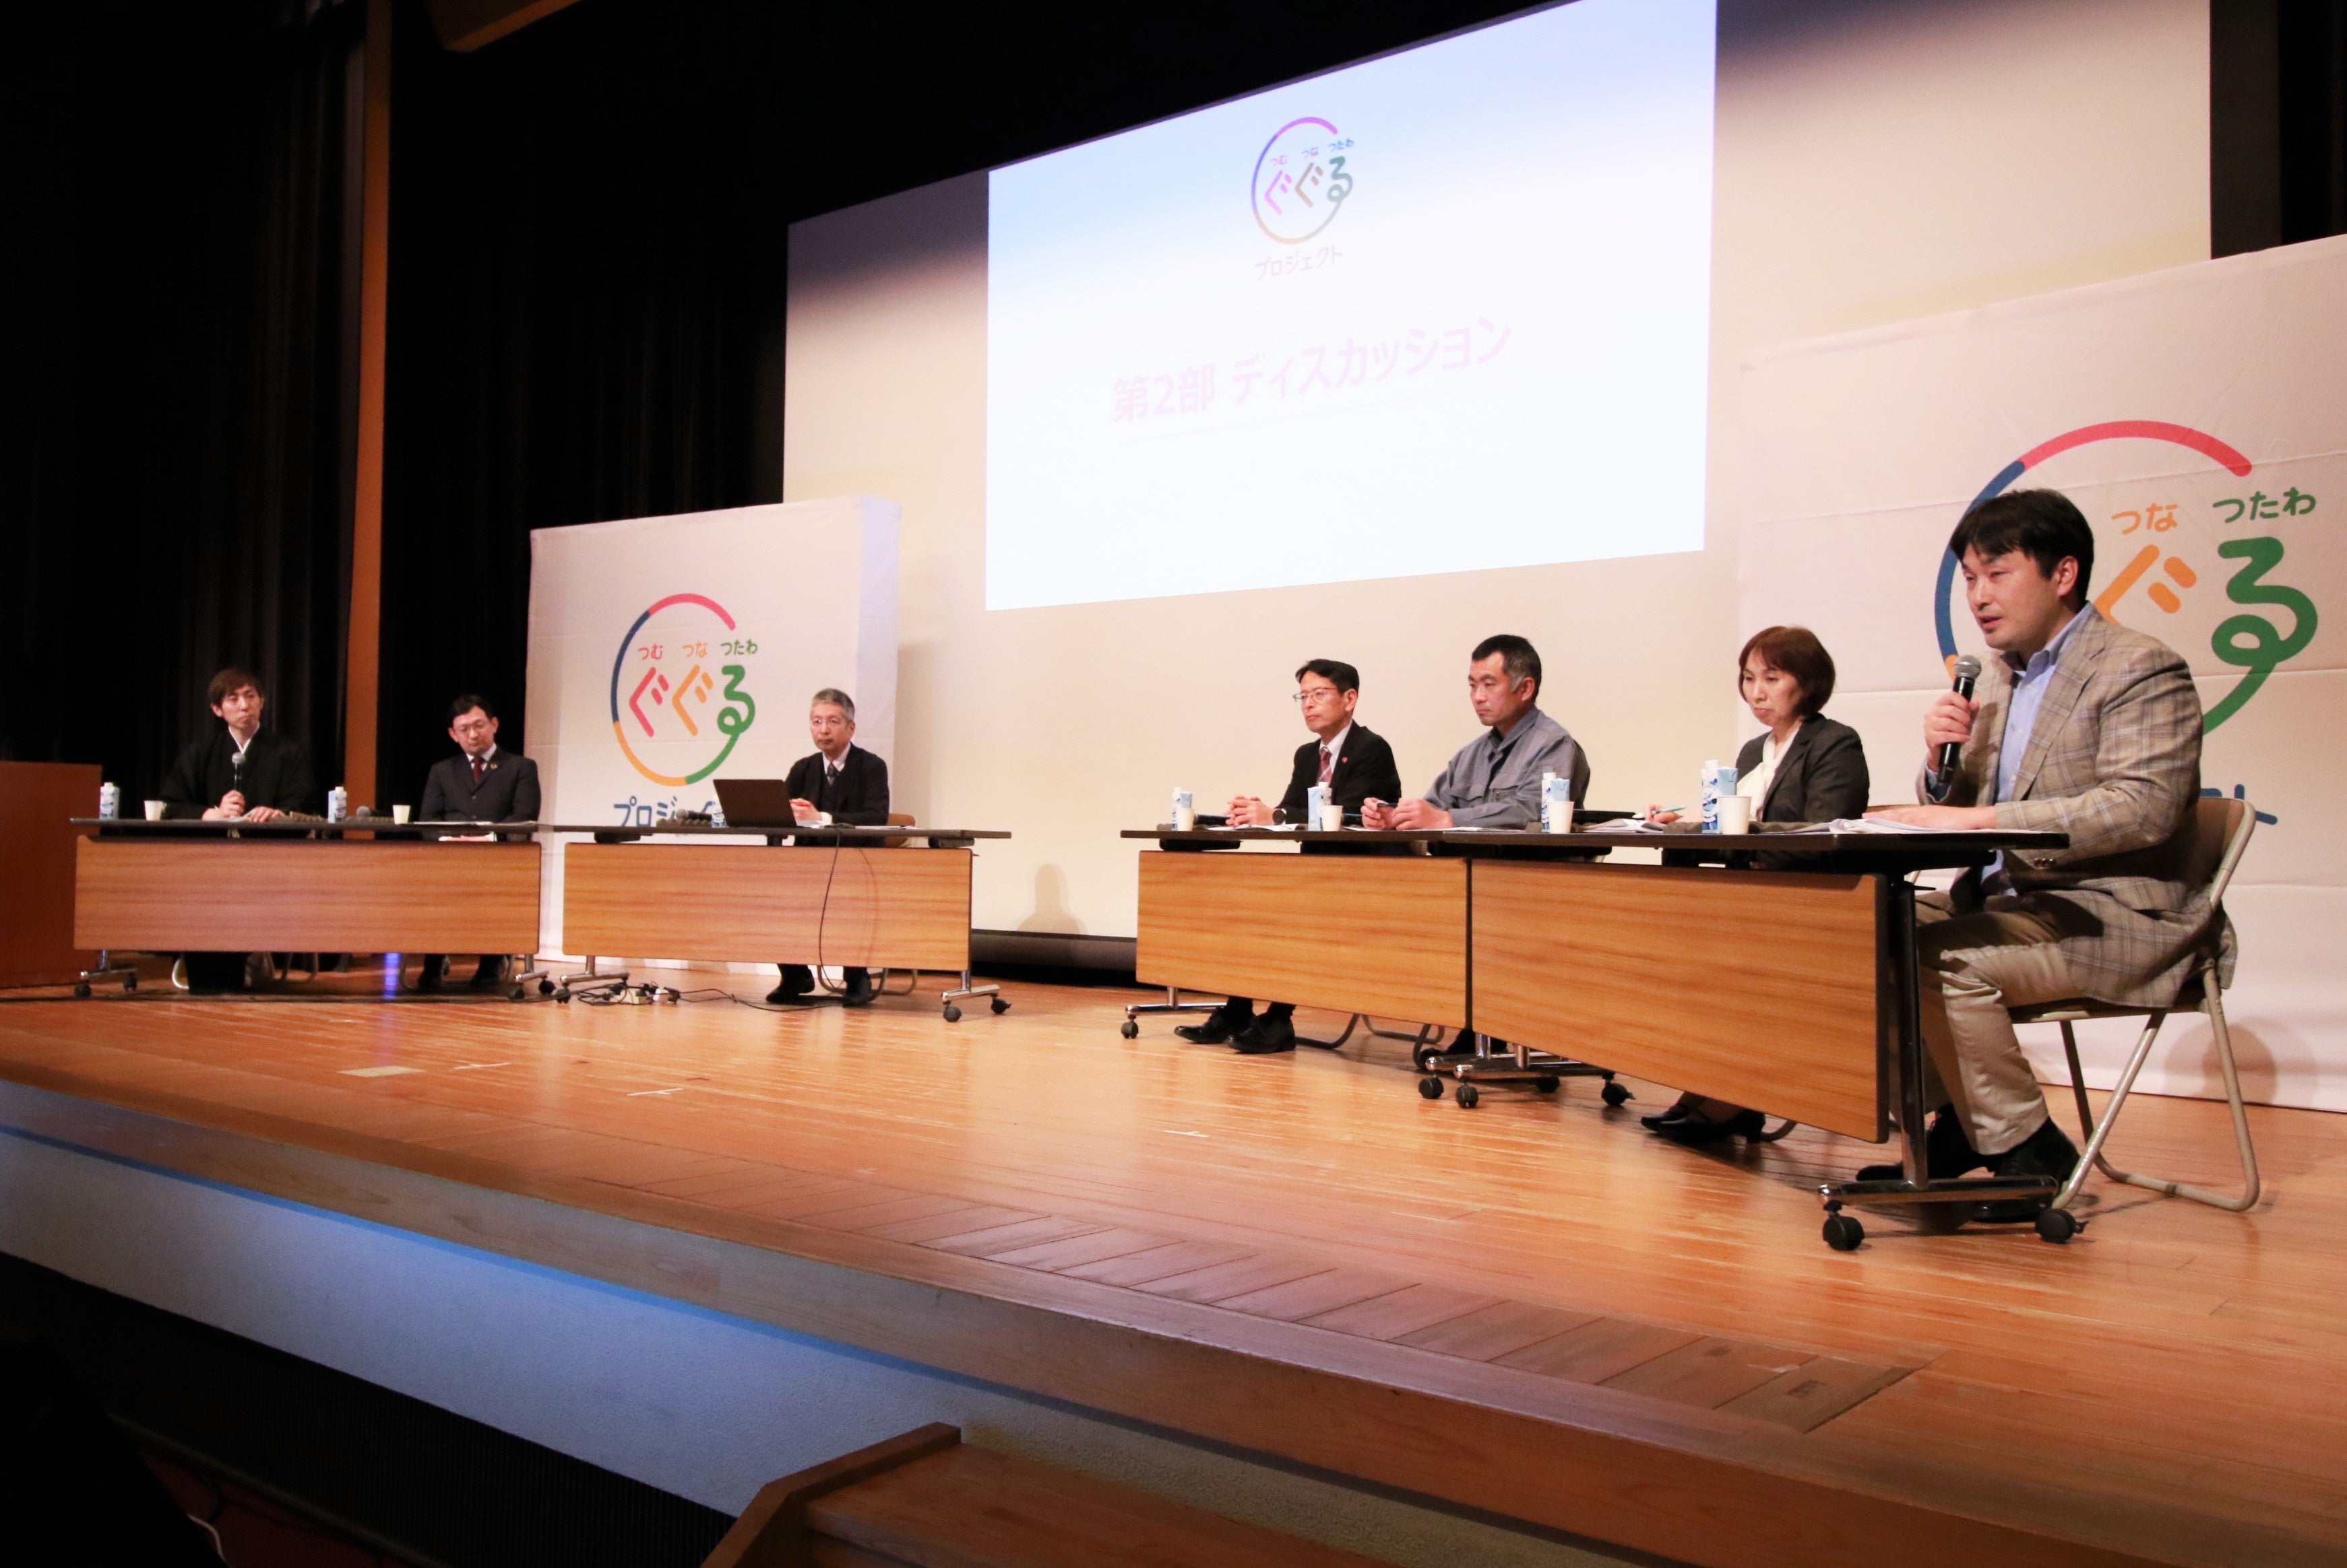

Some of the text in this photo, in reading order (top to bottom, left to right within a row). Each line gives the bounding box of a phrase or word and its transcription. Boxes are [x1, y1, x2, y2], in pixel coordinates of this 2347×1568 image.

[1264, 155, 1354, 216] ぐぐる
[1255, 245, 1342, 281] プロジェクト
[1113, 316, 1511, 424] 第2部 ディスカッション
[2111, 487, 2317, 535] つな つたわ
[638, 638, 758, 660] つむ つな つたわ
[629, 664, 756, 738] ぐぐる
